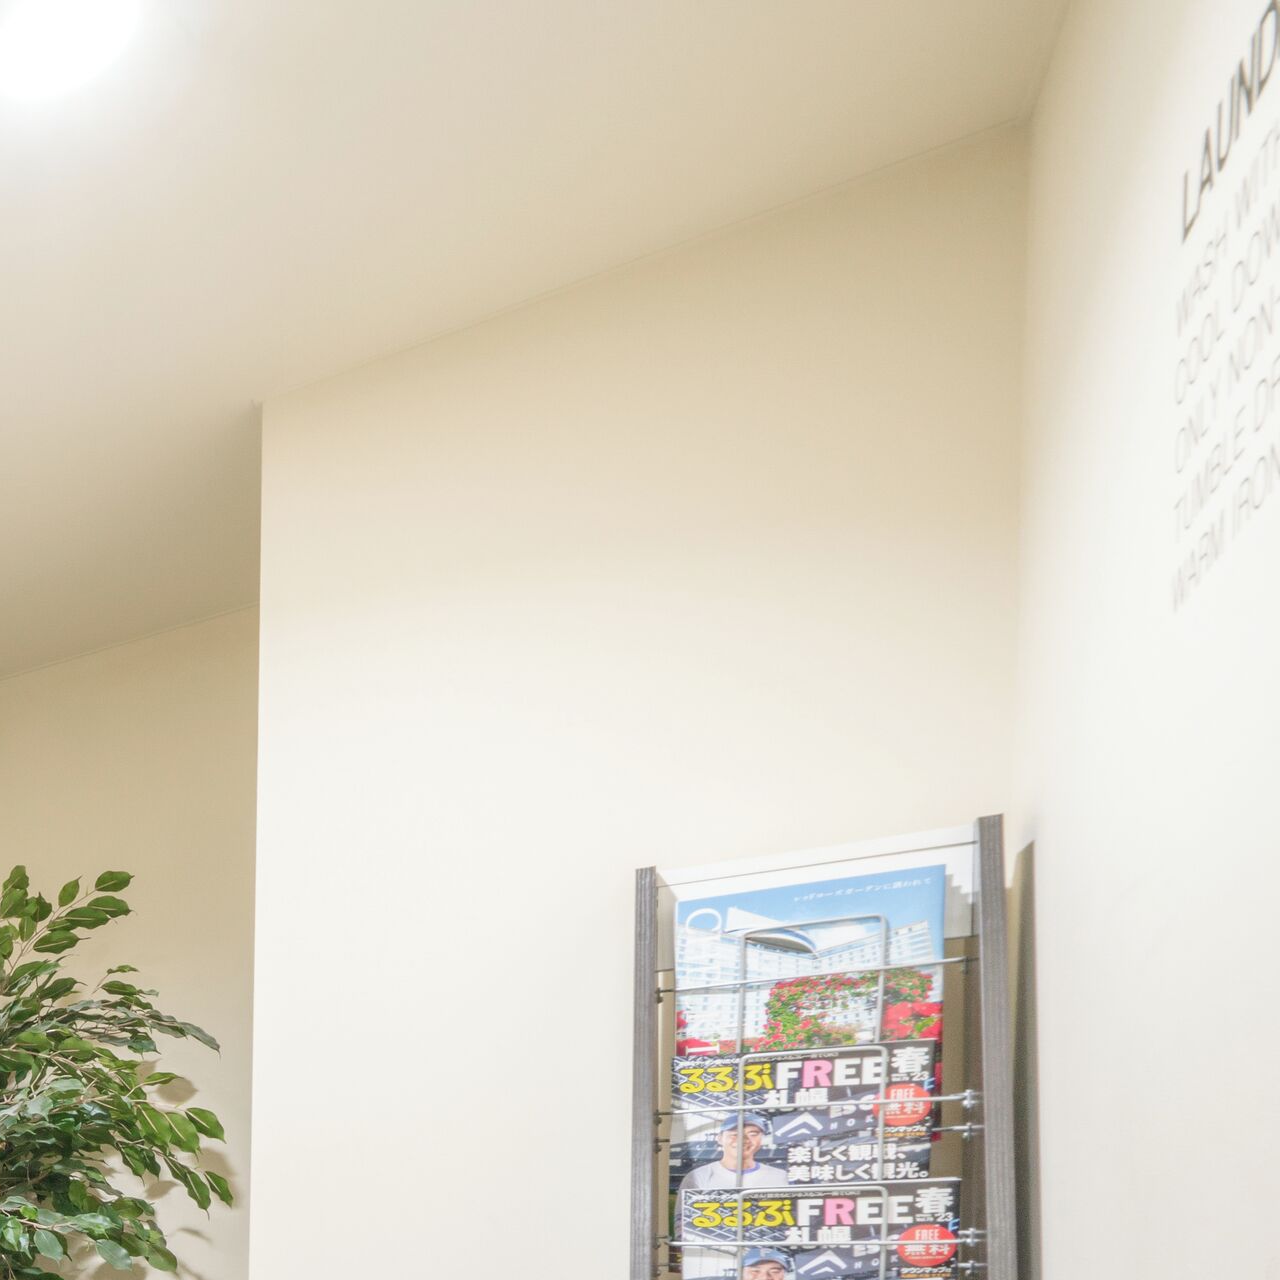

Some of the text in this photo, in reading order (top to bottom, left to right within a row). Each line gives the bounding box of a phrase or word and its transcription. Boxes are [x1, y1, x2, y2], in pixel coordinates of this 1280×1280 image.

[1174, 298, 1224, 404] COOL
[776, 1055, 883, 1090] FREE
[891, 1046, 930, 1074] 春
[889, 1087, 916, 1099] FREE
[788, 1144, 906, 1163] 楽しく観戦、
[788, 1163, 929, 1182] 美味しく観光。
[796, 1194, 913, 1226] FREE
[915, 1187, 953, 1215] 春
[914, 1229, 940, 1241] FREE
